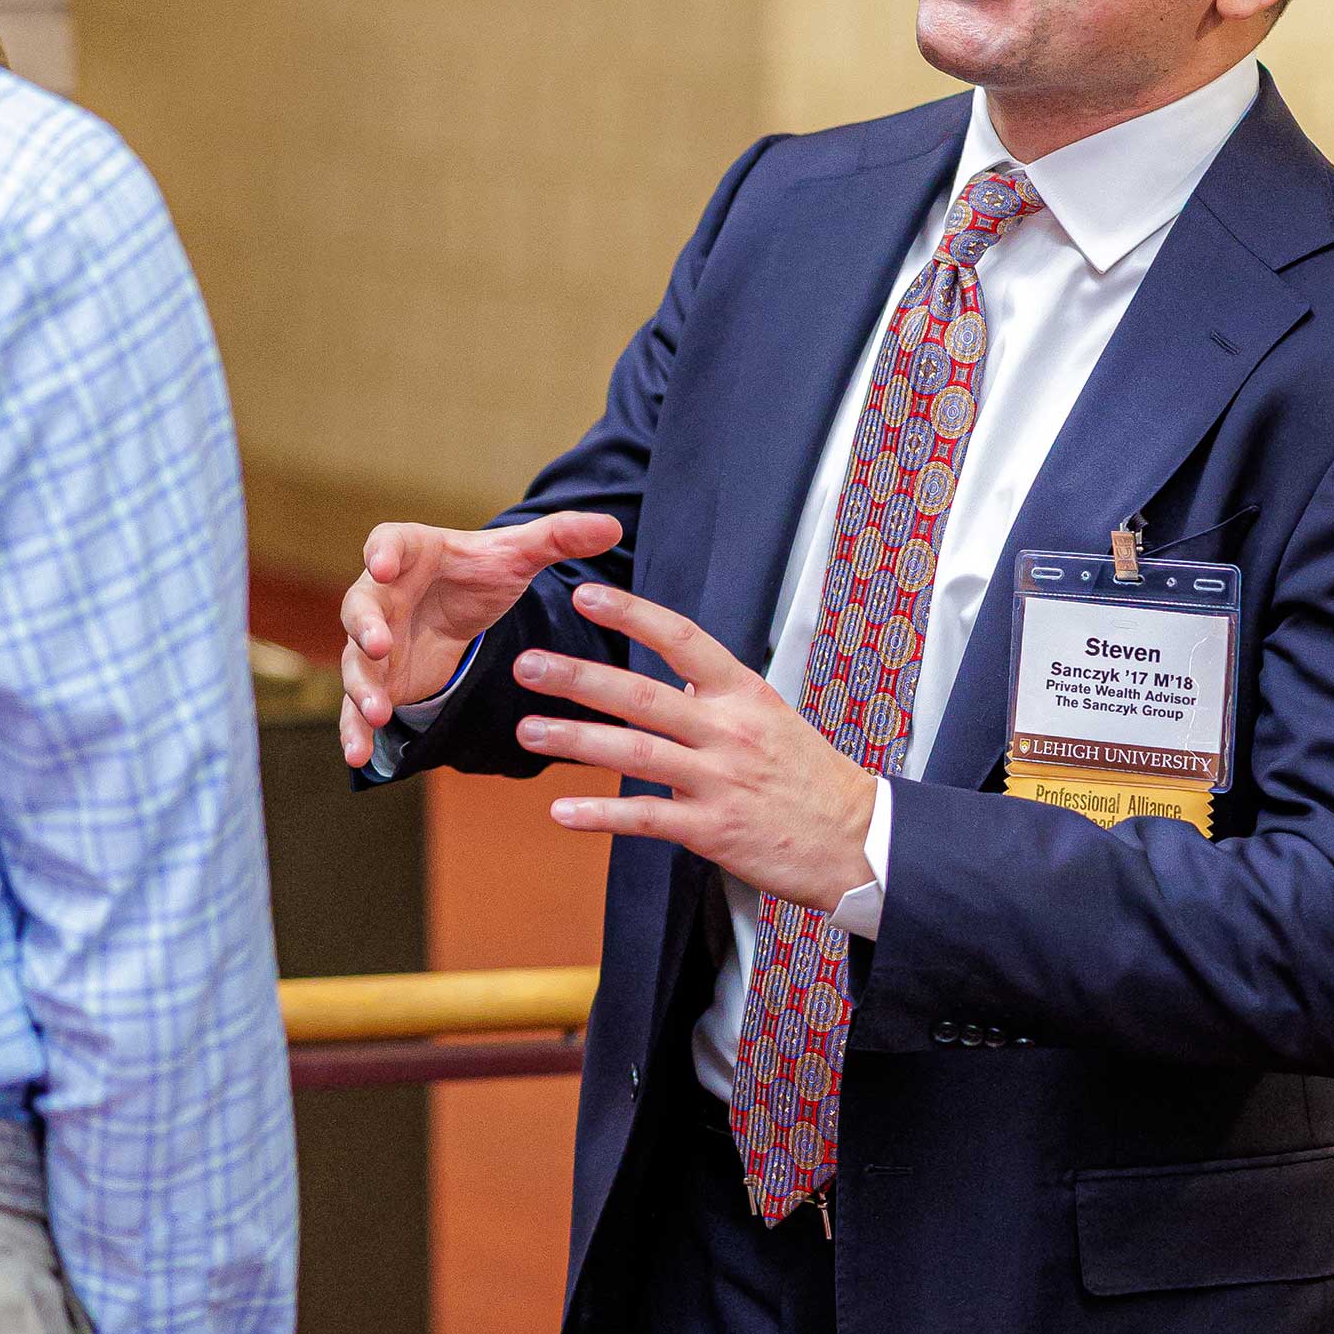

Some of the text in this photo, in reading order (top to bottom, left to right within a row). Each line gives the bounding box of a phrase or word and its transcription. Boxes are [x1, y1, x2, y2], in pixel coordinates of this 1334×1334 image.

[1085, 637, 1160, 663] Steven
[1051, 661, 1193, 690] Sanczyk '17 M'18
[1046, 679, 1197, 706] Private Wealth Advisor
[1056, 695, 1184, 722] The Sanczyk Group
[1032, 739, 1212, 772] LEHIGH UNIVERSITY
[1035, 784, 1182, 819] Professional Alliance
